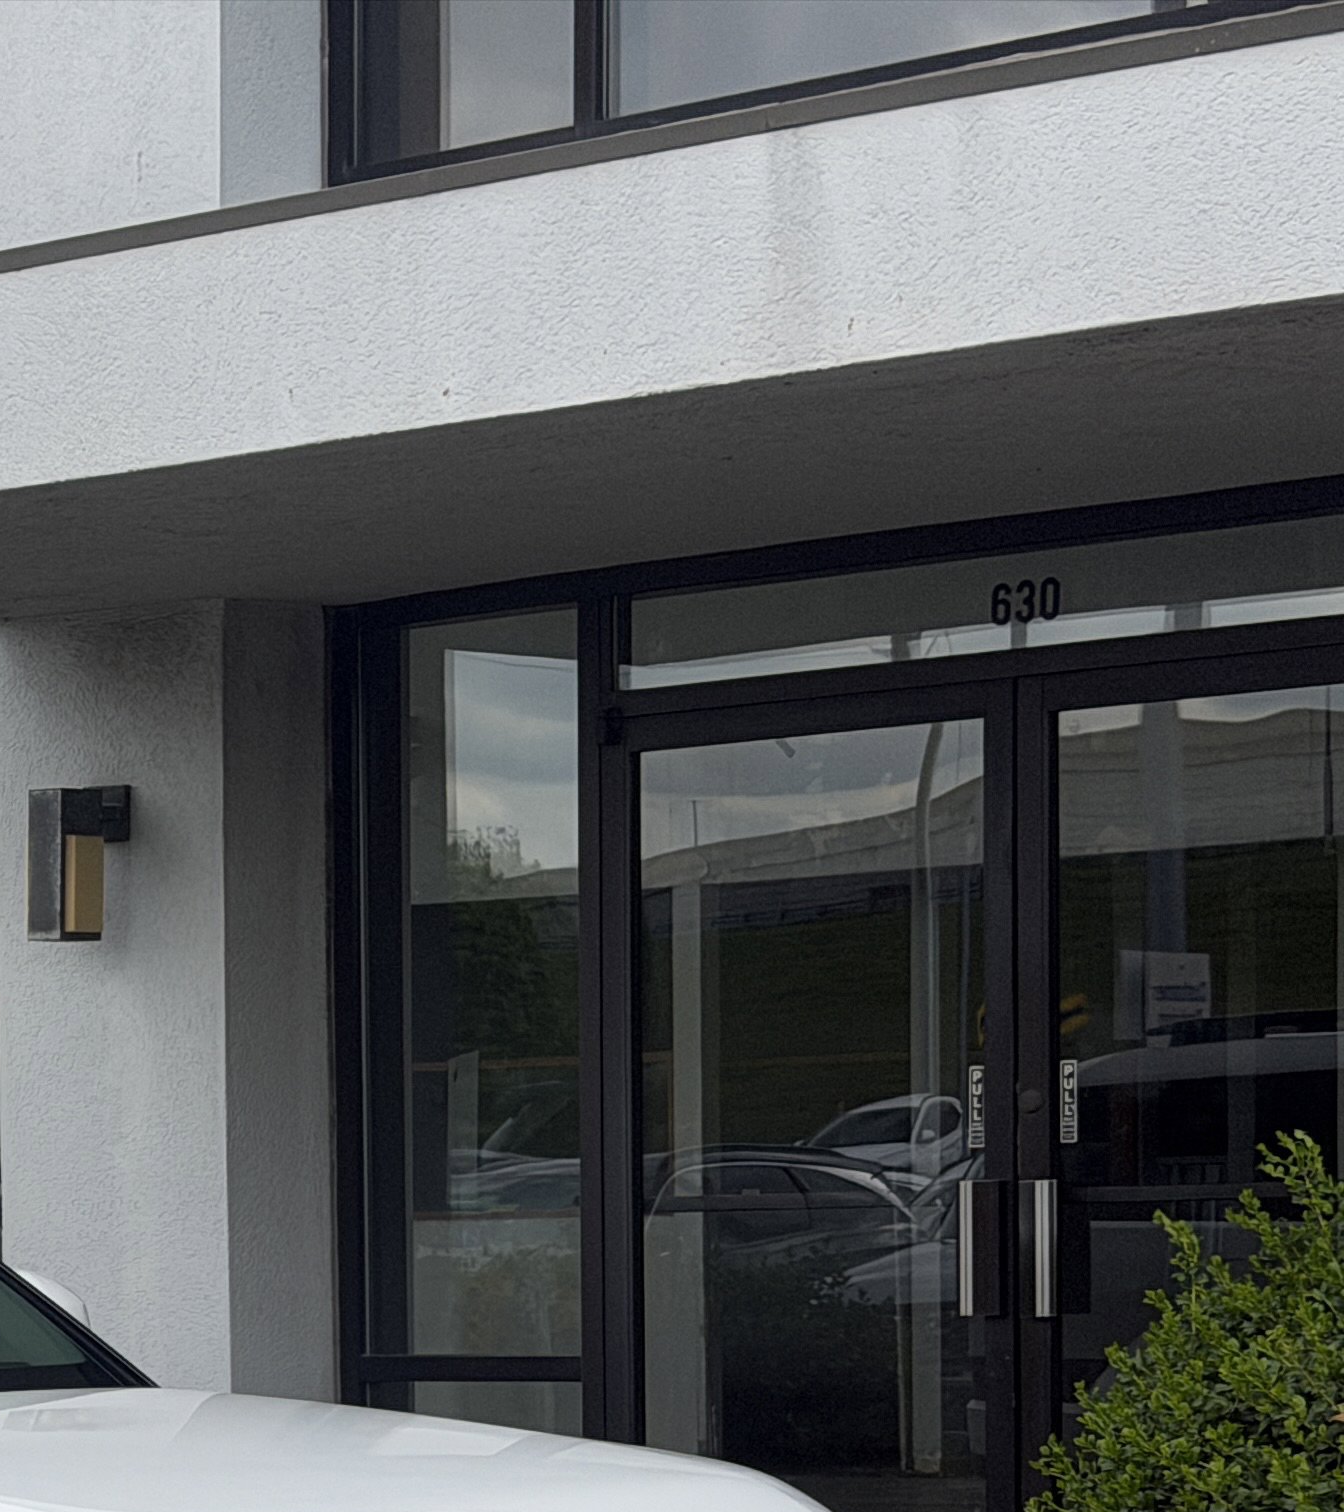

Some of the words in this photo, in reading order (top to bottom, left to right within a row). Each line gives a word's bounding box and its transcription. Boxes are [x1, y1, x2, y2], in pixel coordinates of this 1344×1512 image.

[990, 577, 1061, 626] 630
[972, 1070, 983, 1121] PULL
[1062, 1064, 1075, 1116] PULL
